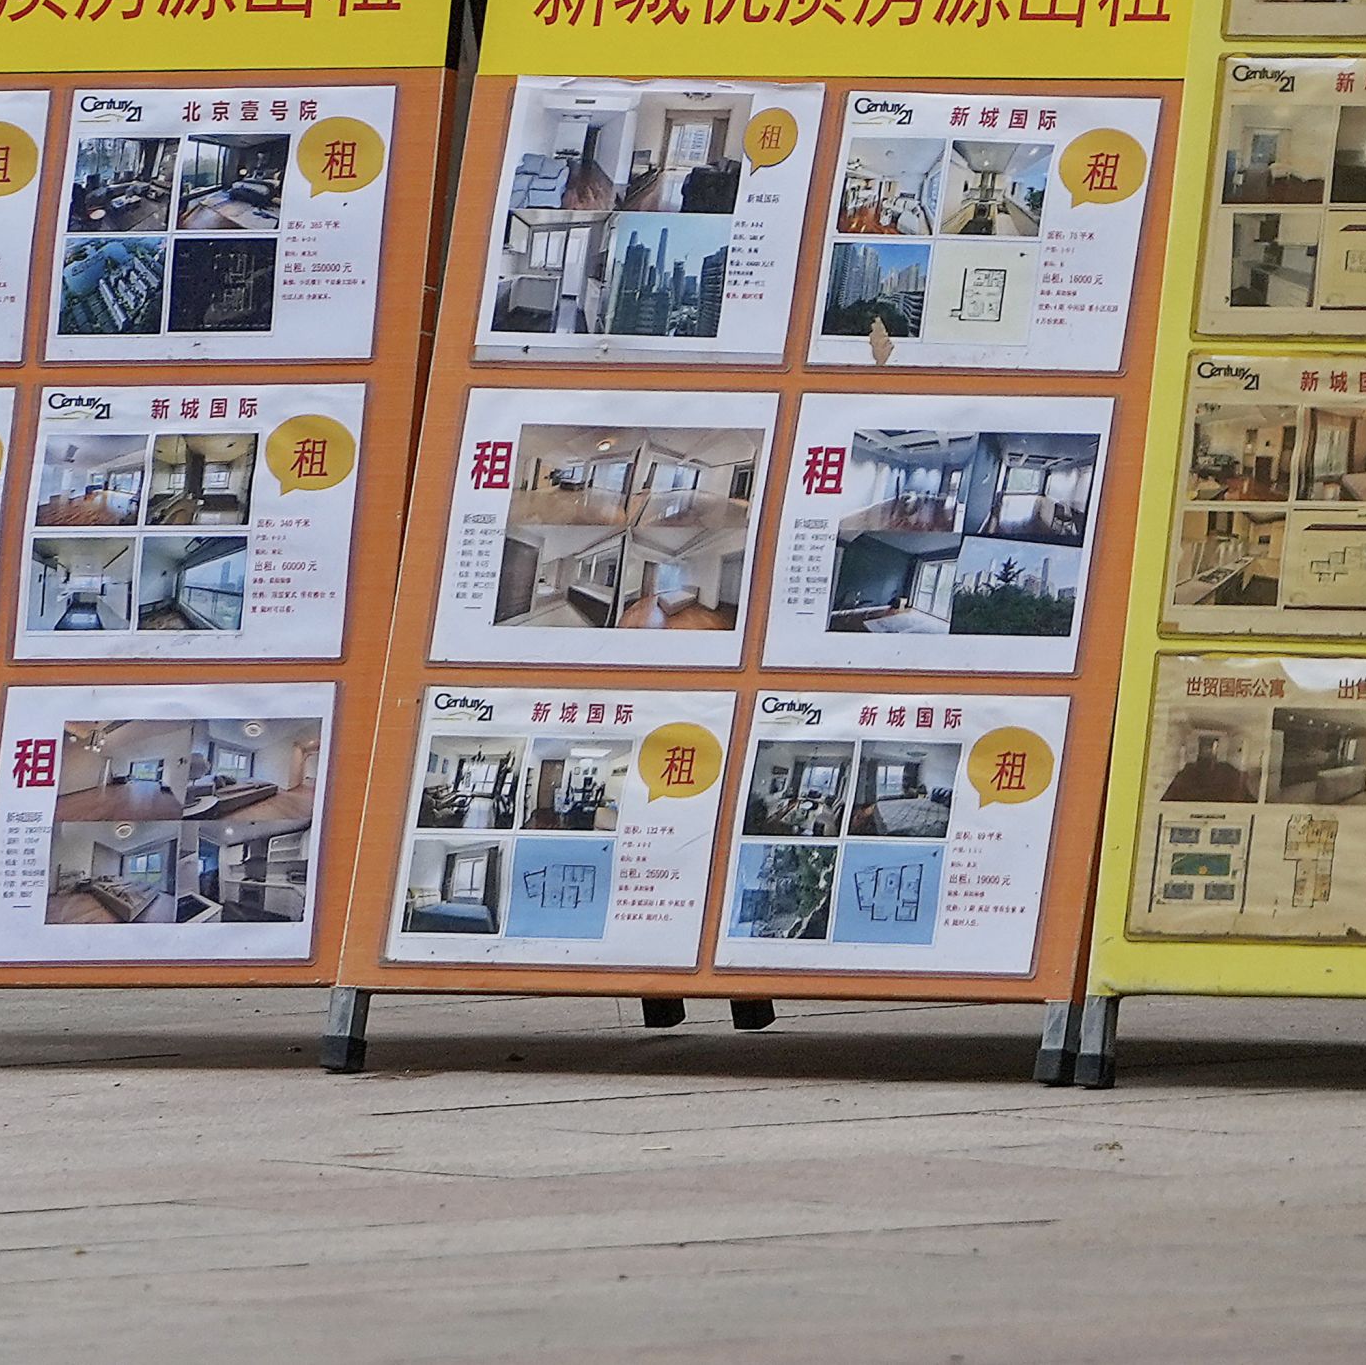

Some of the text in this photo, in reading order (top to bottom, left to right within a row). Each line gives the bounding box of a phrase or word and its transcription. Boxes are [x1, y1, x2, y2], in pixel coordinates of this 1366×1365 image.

[80, 96, 142, 122] Century 21
[182, 100, 318, 122] 北京壹号院
[854, 98, 912, 125] Century 21
[950, 106, 1057, 130] 新城国际
[758, 124, 782, 150] 租
[322, 140, 357, 180] 租
[1083, 152, 1120, 191] 租
[151, 398, 257, 419] 新城国际
[290, 437, 328, 478] 租
[471, 441, 514, 489] 租
[803, 446, 846, 494] 租
[1187, 677, 1285, 699] 世贸国际公寓
[532, 702, 633, 724] 新城国际
[858, 706, 962, 728] 新城国际
[13, 738, 56, 788] 租
[661, 746, 696, 787] 租
[991, 751, 1027, 791] 租
